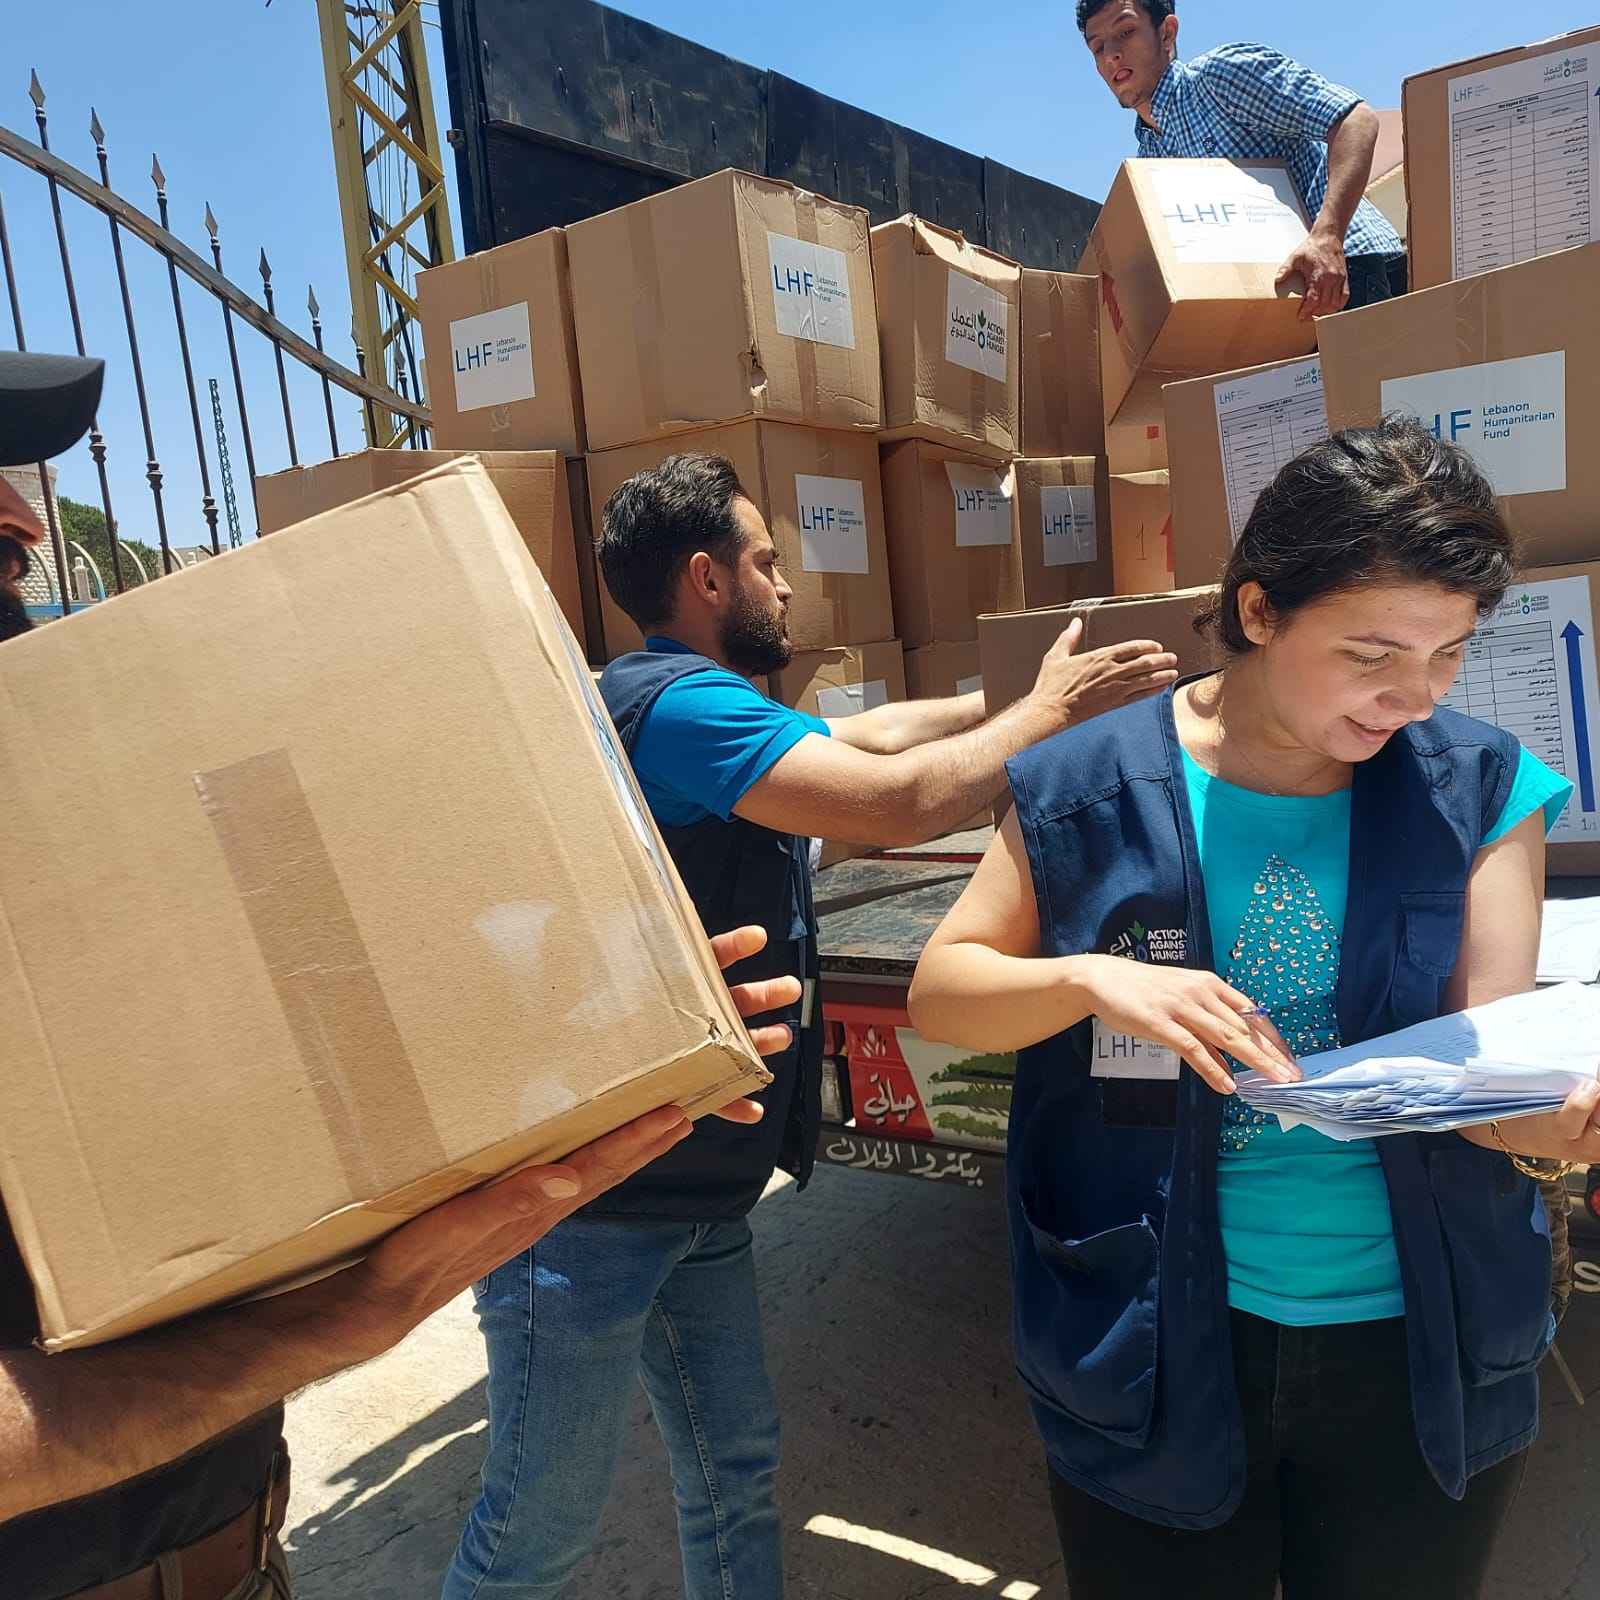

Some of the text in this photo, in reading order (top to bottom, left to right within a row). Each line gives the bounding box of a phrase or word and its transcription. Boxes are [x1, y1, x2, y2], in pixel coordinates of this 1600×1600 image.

[1454, 87, 1473, 102] LHF
[1176, 204, 1237, 222] LHF
[774, 264, 813, 296] LHF
[951, 305, 976, 331] العمل
[987, 320, 1005, 337] ACTION
[455, 342, 492, 372] LHF
[1482, 401, 1530, 416] Lebanon
[1483, 411, 1555, 428] Humanitarian
[1483, 428, 1510, 441] Fund
[955, 489, 985, 511] LHF
[801, 505, 835, 531] LHF
[1044, 514, 1072, 535] LHF
[1147, 929, 1187, 940] ACTION
[1098, 1035, 1142, 1058] LHF
[863, 1072, 917, 1126] حياتي
